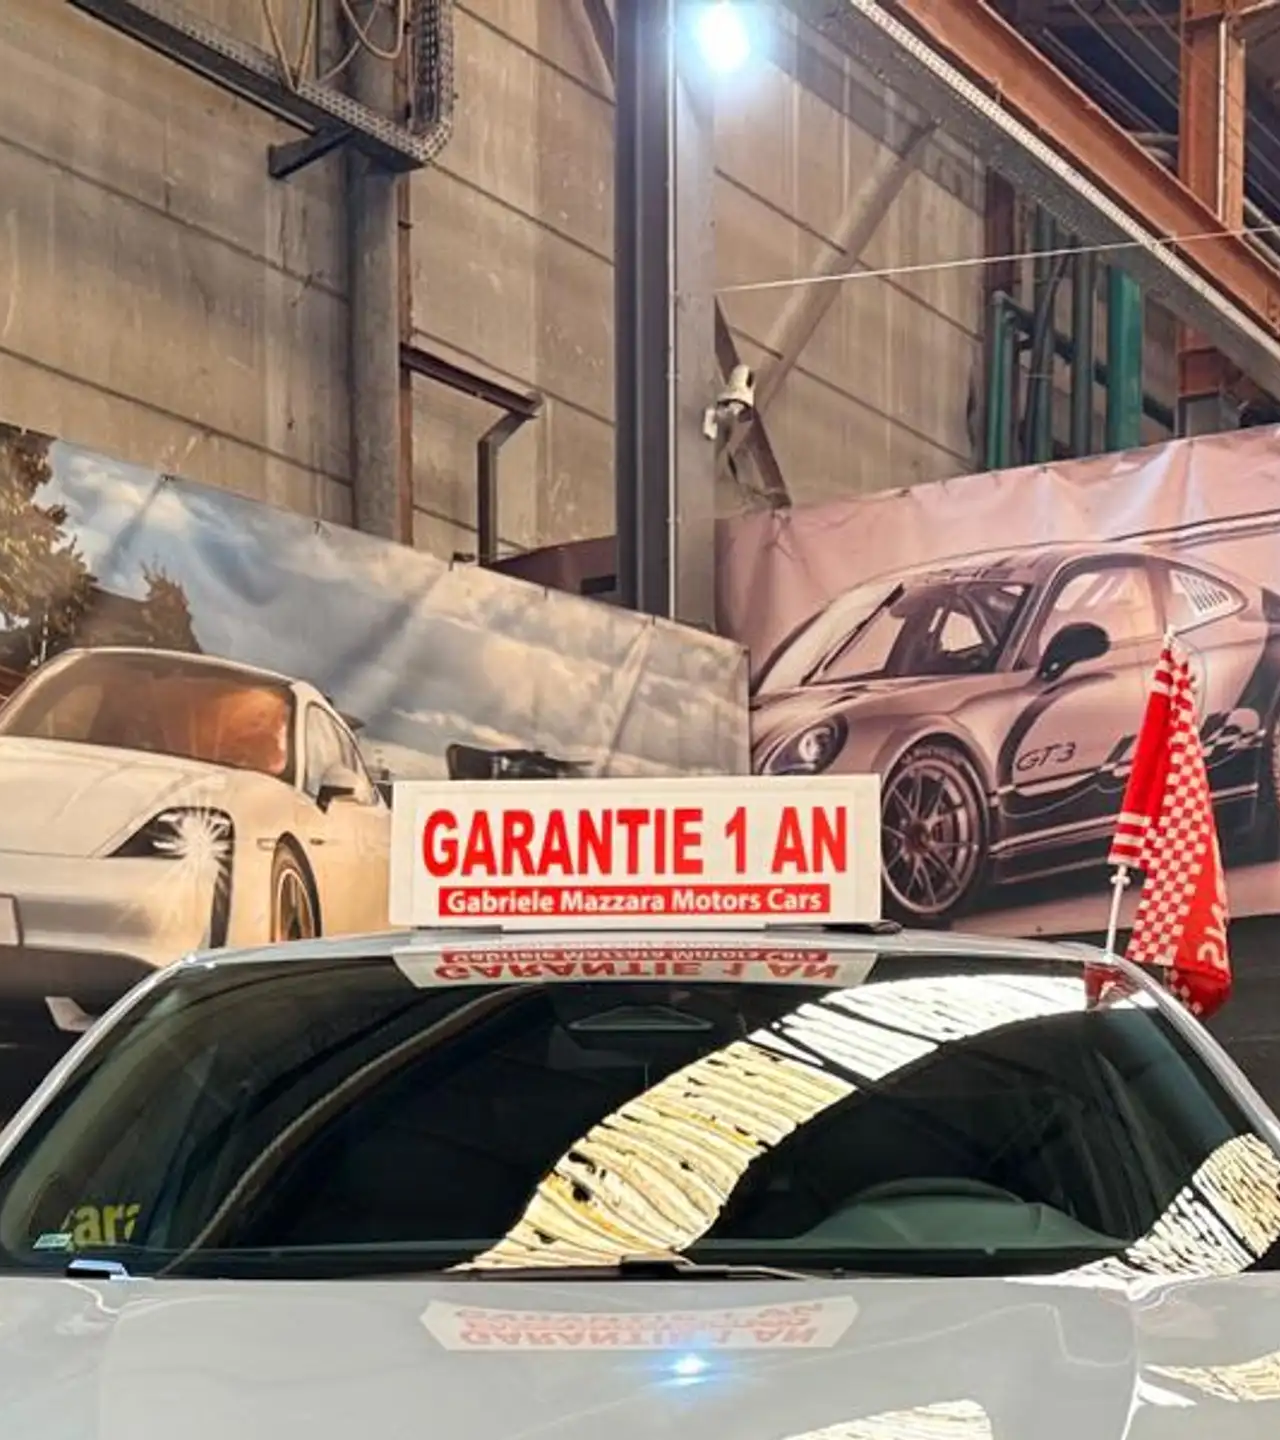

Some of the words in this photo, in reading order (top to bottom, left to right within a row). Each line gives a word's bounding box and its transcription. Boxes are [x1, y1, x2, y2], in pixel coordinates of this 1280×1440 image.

[1017, 741, 1076, 771] GT3
[422, 808, 704, 877] GARANTIE
[725, 806, 747, 875] 1
[772, 806, 847, 874] AN
[447, 889, 554, 914] Gabriele
[560, 890, 665, 913] Mazzara
[674, 889, 761, 912] Motors
[770, 888, 822, 911] Cars
